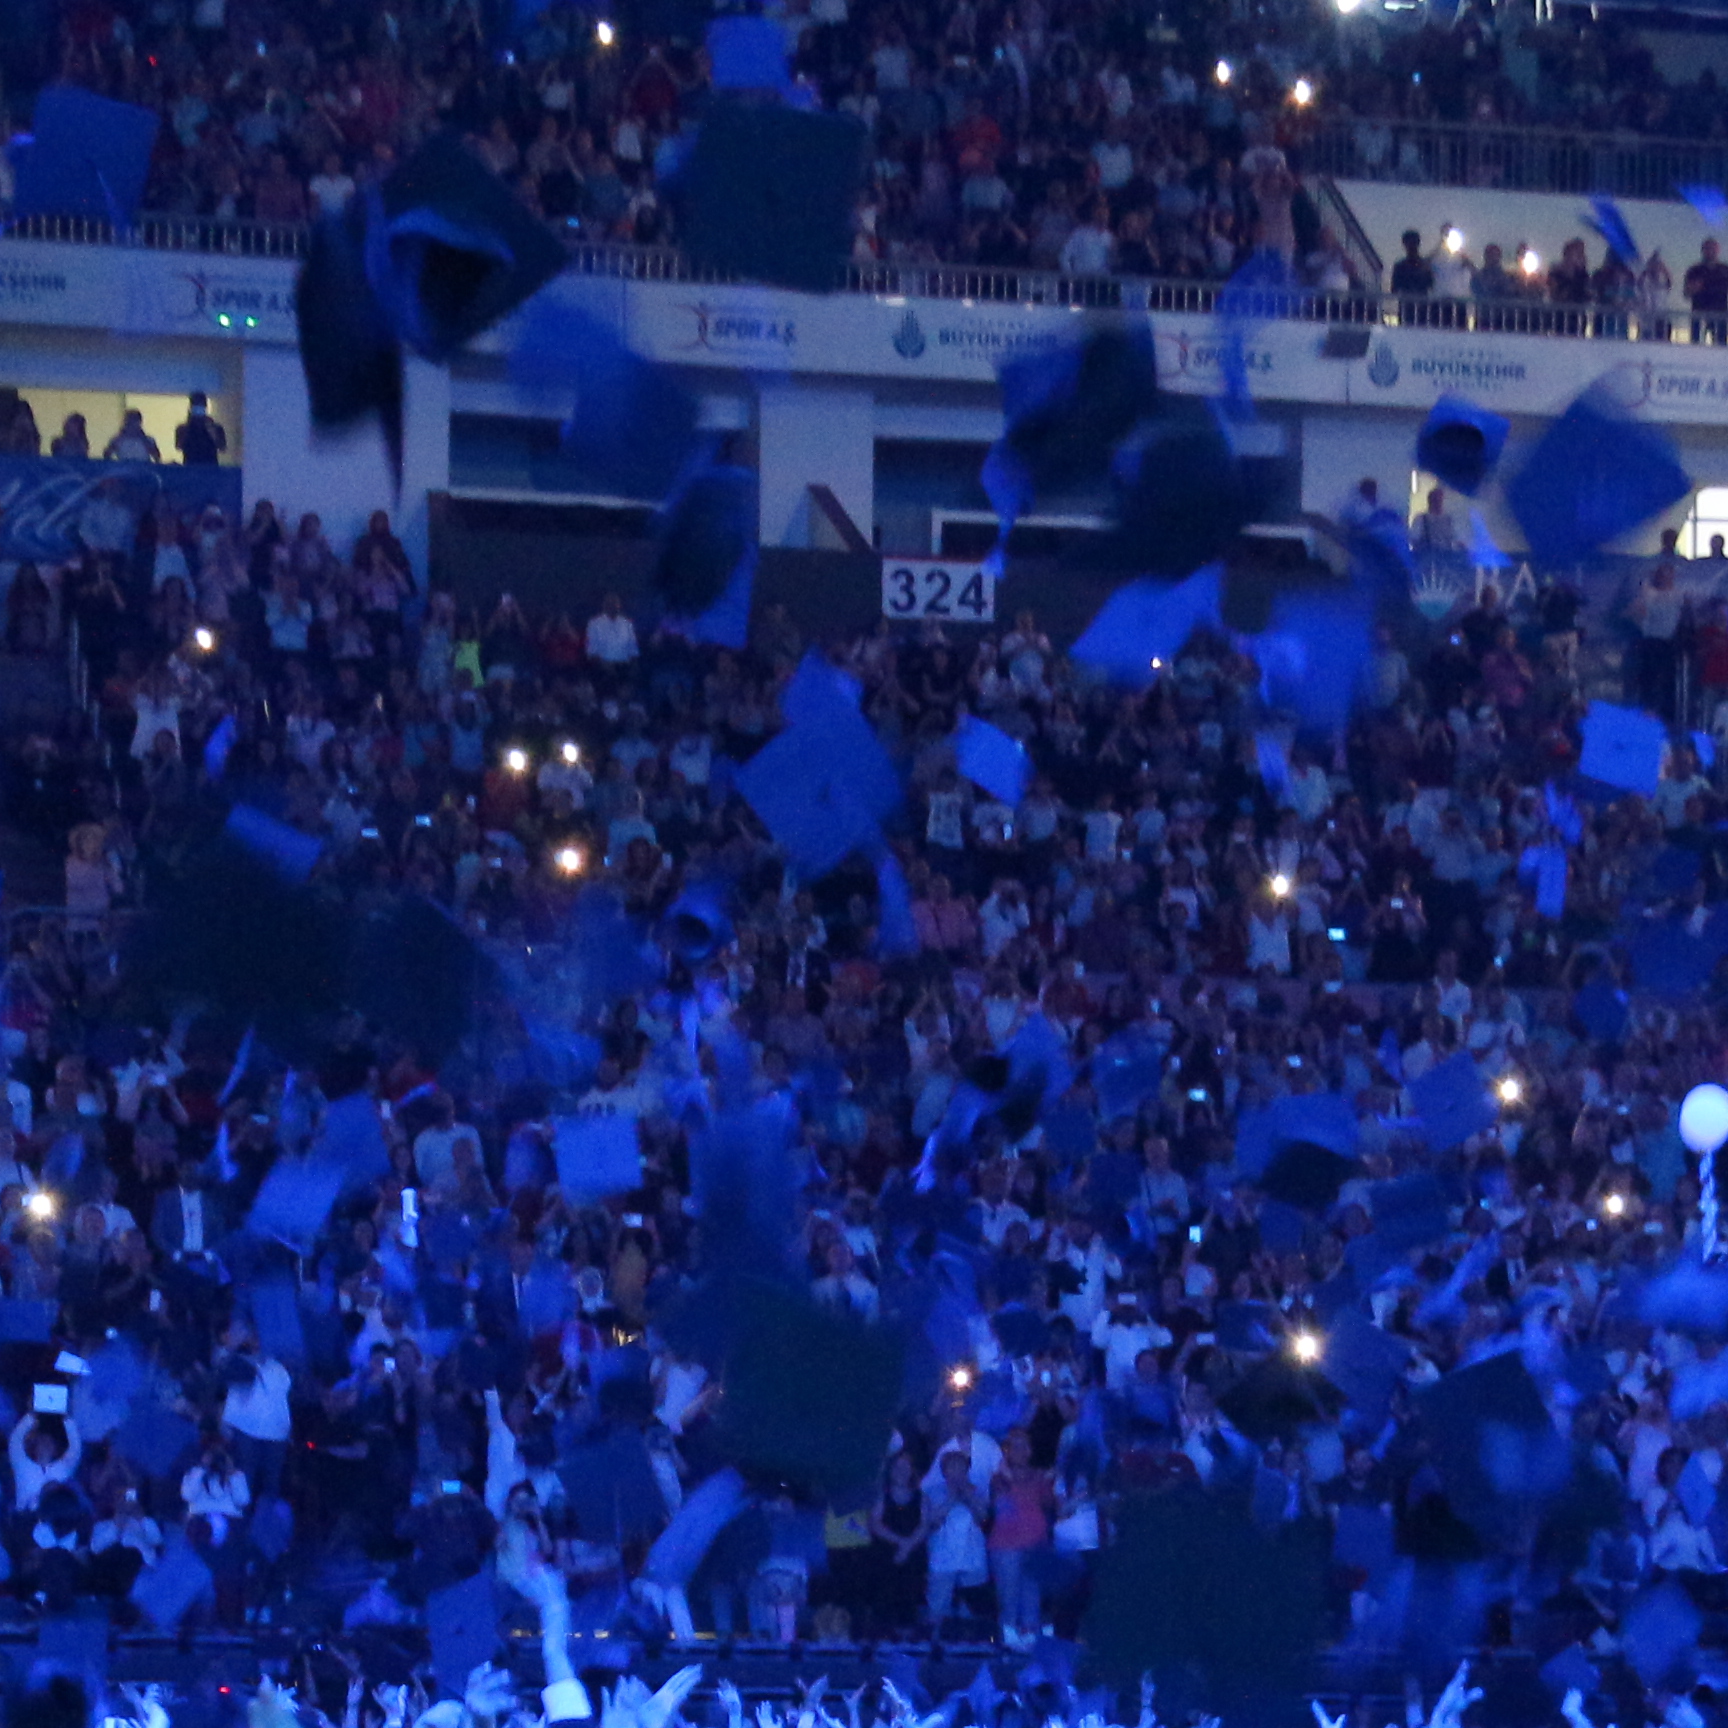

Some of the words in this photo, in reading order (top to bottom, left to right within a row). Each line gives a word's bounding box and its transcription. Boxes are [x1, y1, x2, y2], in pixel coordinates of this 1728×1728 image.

[713, 318, 761, 339] SPOR
[1656, 376, 1700, 395] SPOR
[888, 569, 988, 617] 324
